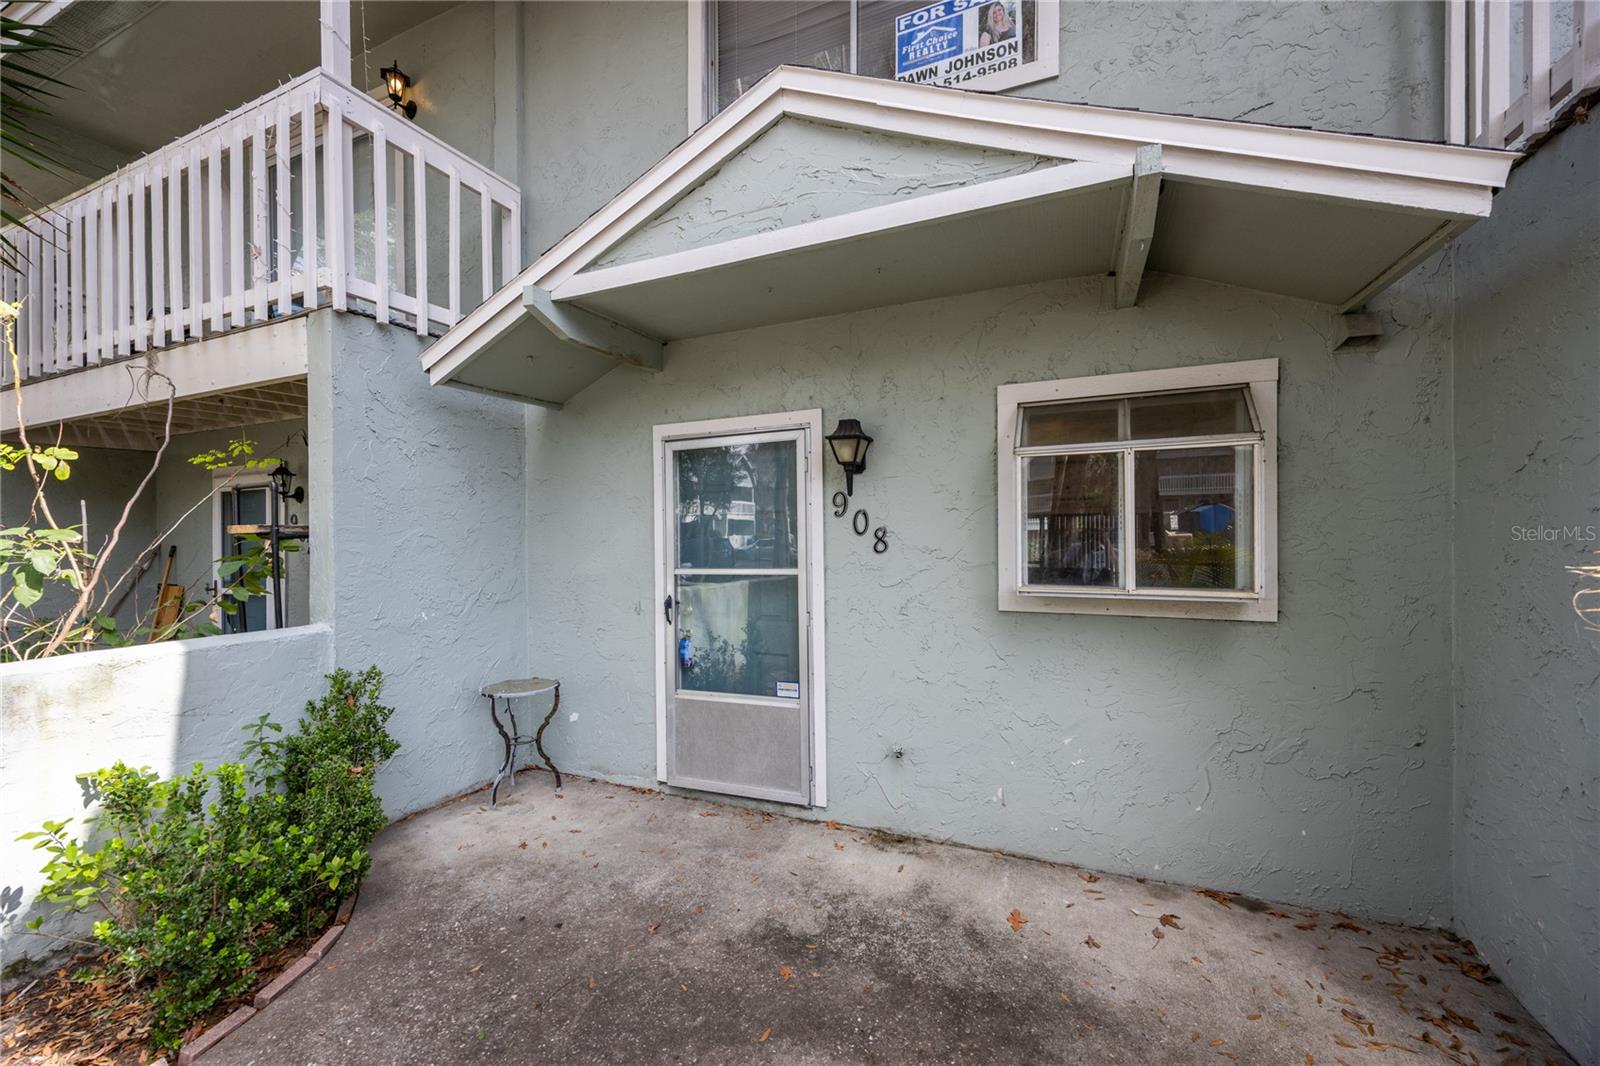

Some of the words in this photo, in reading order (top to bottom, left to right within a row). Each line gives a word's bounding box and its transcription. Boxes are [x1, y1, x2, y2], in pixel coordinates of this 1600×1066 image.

[899, 5, 946, 31] FOR
[902, 42, 925, 55] First
[926, 31, 958, 46] Choice
[909, 40, 948, 60] REALTY
[944, 40, 1019, 75] JOHNSON
[943, 57, 1018, 86] 514-9508
[832, 491, 887, 554] 908
